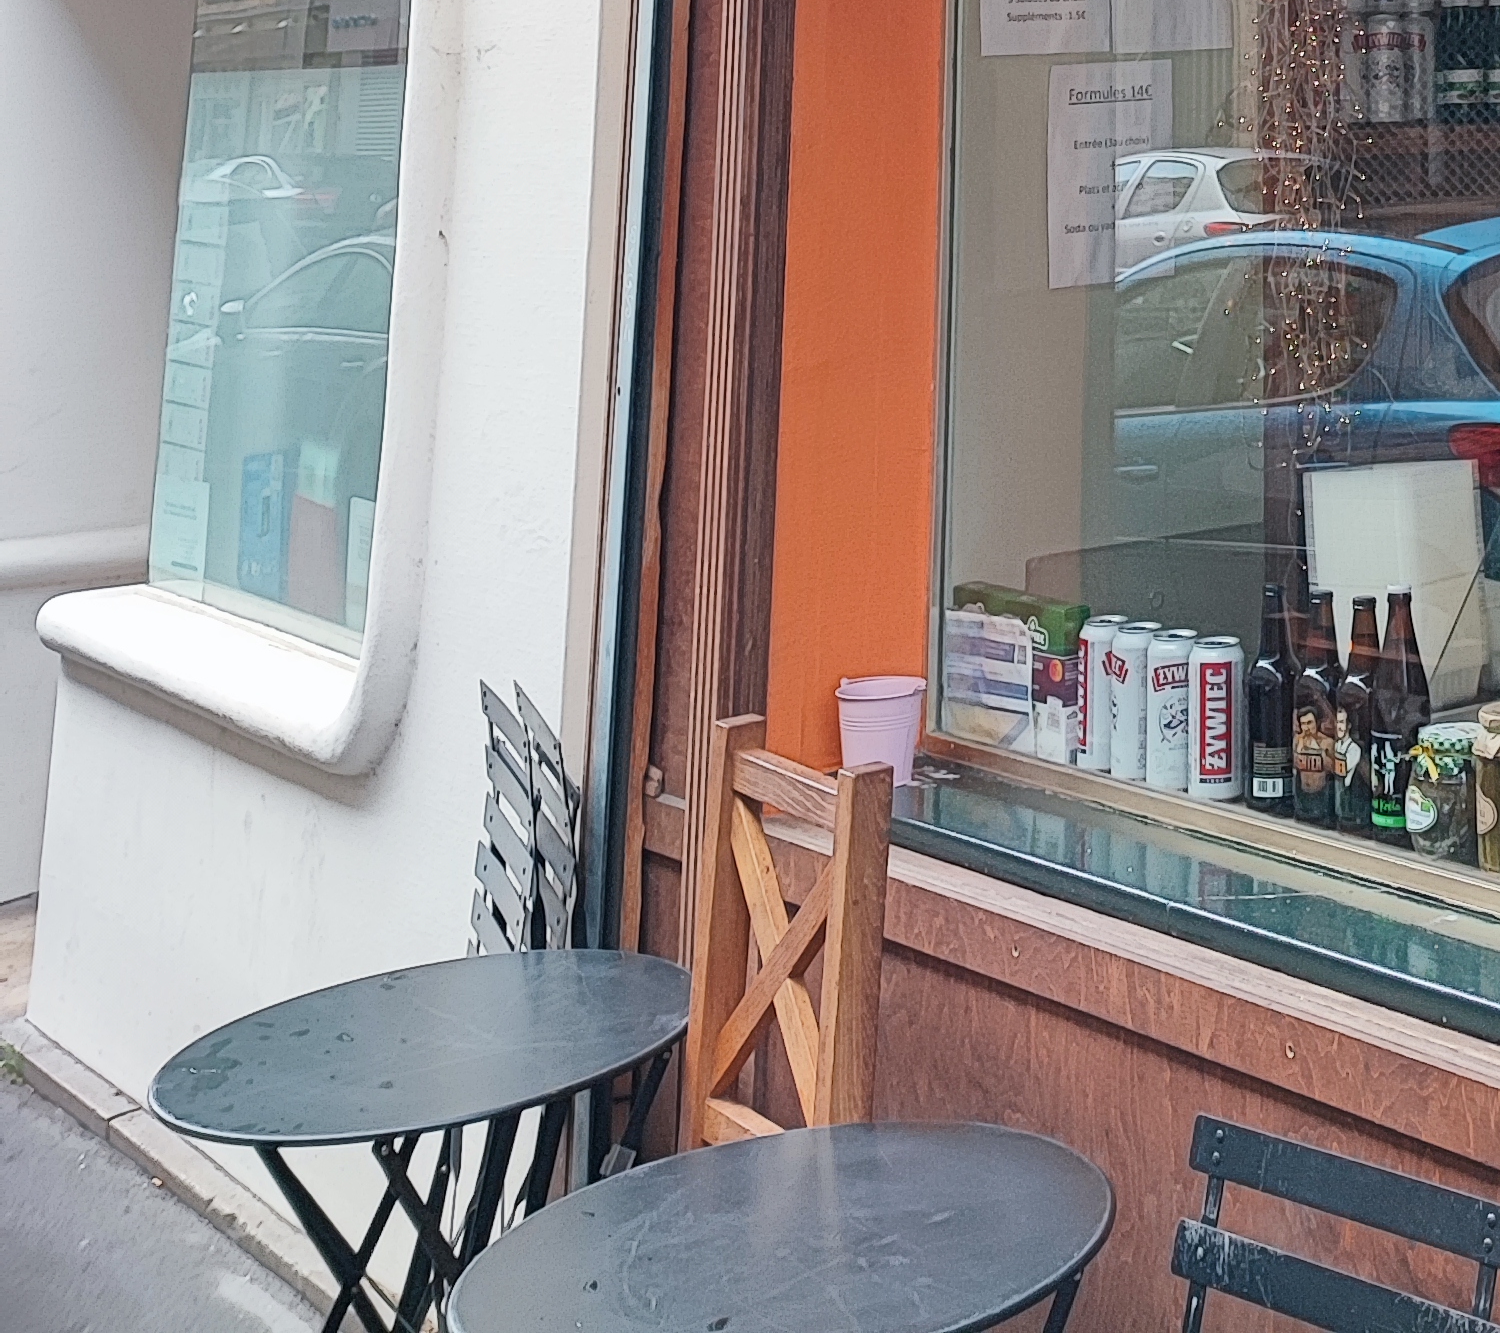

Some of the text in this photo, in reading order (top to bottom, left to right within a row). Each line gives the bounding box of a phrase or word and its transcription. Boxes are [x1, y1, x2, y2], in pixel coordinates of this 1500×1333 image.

[1006, 11, 1062, 22] Suppléments
[1068, 84, 1153, 102] Formules 14€
[1155, 663, 1189, 684] ŻYW
[1201, 667, 1228, 771] ŻYWIEC
